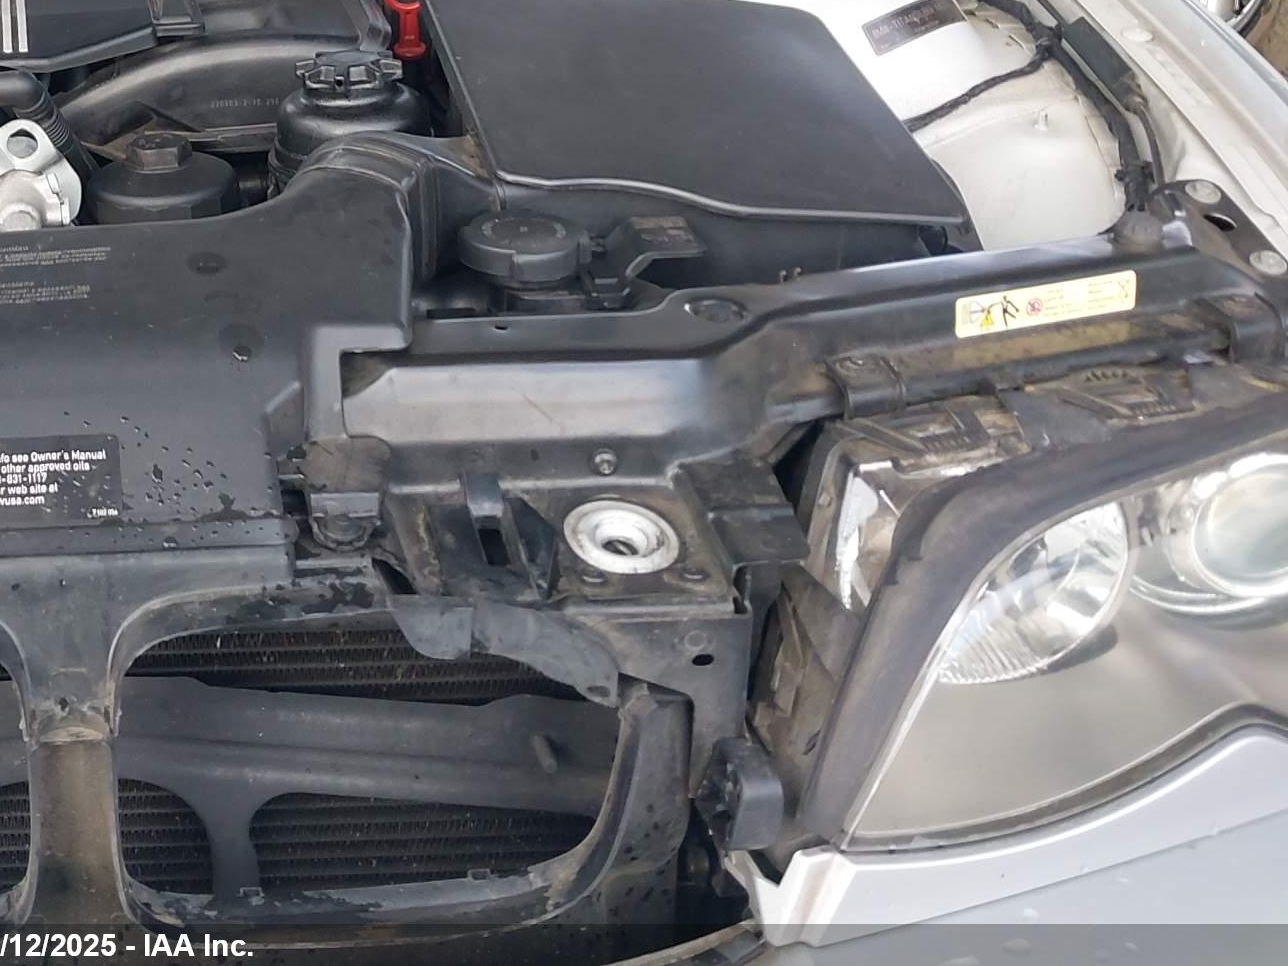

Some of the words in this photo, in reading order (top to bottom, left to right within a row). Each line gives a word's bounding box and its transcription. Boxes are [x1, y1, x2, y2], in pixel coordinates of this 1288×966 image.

[12, 453, 29, 463] see
[30, 450, 69, 462] Owner's
[71, 449, 107, 461] Manual
[1, 462, 26, 474] other
[27, 461, 71, 474] approved
[72, 460, 90, 471] oils
[8, 484, 28, 495] web
[30, 482, 47, 494] site
[47, 482, 58, 493] at
